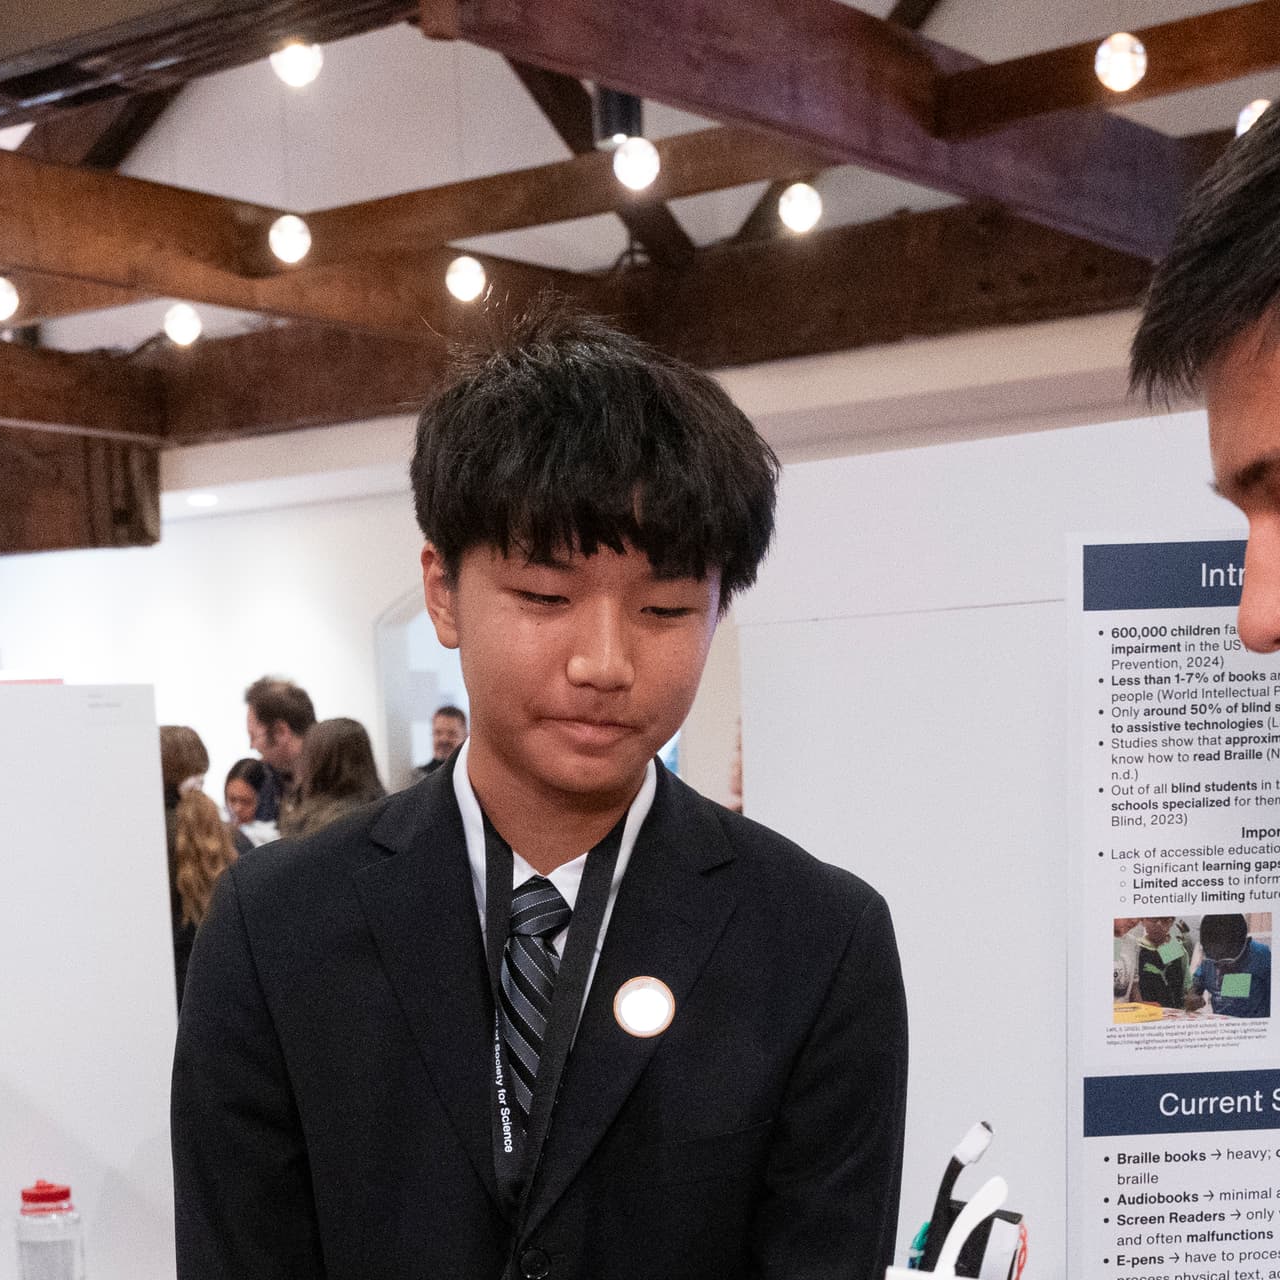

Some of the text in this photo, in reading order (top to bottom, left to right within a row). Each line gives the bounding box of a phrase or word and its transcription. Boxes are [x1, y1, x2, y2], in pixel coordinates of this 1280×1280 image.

[1111, 625, 1167, 640] 600,000
[1170, 624, 1220, 637] children
[1111, 638, 1242, 655] impairment the US
[1111, 655, 1224, 670] Prevention, 2024)
[1111, 675, 1141, 686] Less
[1143, 674, 1171, 685] than
[1174, 671, 1209, 684] 1-7%
[1228, 670, 1266, 682] books
[1111, 690, 1153, 703] people
[1157, 688, 1198, 702] (World
[1201, 685, 1270, 699] Intellectual
[1111, 706, 1139, 719] Only
[1143, 704, 1186, 717] around
[1190, 703, 1222, 715] 50%
[1225, 702, 1238, 714] of
[1241, 701, 1271, 713] blind
[1126, 720, 1181, 733] assistive
[1183, 717, 1263, 731] technologies
[1111, 737, 1158, 749] Studies
[1161, 735, 1193, 747] show
[1197, 735, 1221, 746] that
[1111, 753, 1144, 764] know
[1147, 752, 1173, 763] how
[1177, 751, 1189, 762] to
[1192, 749, 1220, 762] read
[1223, 748, 1263, 761] Braille
[1111, 768, 1138, 782] n.d.)
[1111, 784, 1133, 796] Out
[1153, 783, 1167, 794] all
[1171, 781, 1201, 794] blind
[1204, 780, 1257, 793] students
[1111, 799, 1159, 811] schools
[1162, 796, 1230, 811] specialized
[1233, 795, 1251, 806] for
[1111, 812, 1187, 827] Blind, 2023)
[1111, 847, 1140, 860] Lack
[1143, 847, 1156, 858] of
[1159, 844, 1224, 858] accessible
[1132, 861, 1198, 875] Significant
[1202, 859, 1251, 872] learning
[1133, 877, 1178, 889] Limited
[1181, 877, 1224, 888] access
[1133, 892, 1198, 904] Potentially
[1201, 890, 1245, 903] limiting
[497, 1089, 507, 1105] for
[1159, 1090, 1263, 1116] Current
[500, 1107, 513, 1153] Science
[1117, 1151, 1160, 1165] Braille
[1164, 1149, 1206, 1163] books
[1117, 1172, 1159, 1185] braille
[1116, 1191, 1199, 1206] Audiobooks
[1219, 1187, 1271, 1201] minimal
[1116, 1214, 1165, 1226] Screen
[1168, 1210, 1225, 1224] Readers
[1246, 1207, 1274, 1222] only
[1116, 1228, 1274, 1246] and often malfunctions
[1116, 1254, 1164, 1268] E-pens
[1184, 1251, 1216, 1263] have
